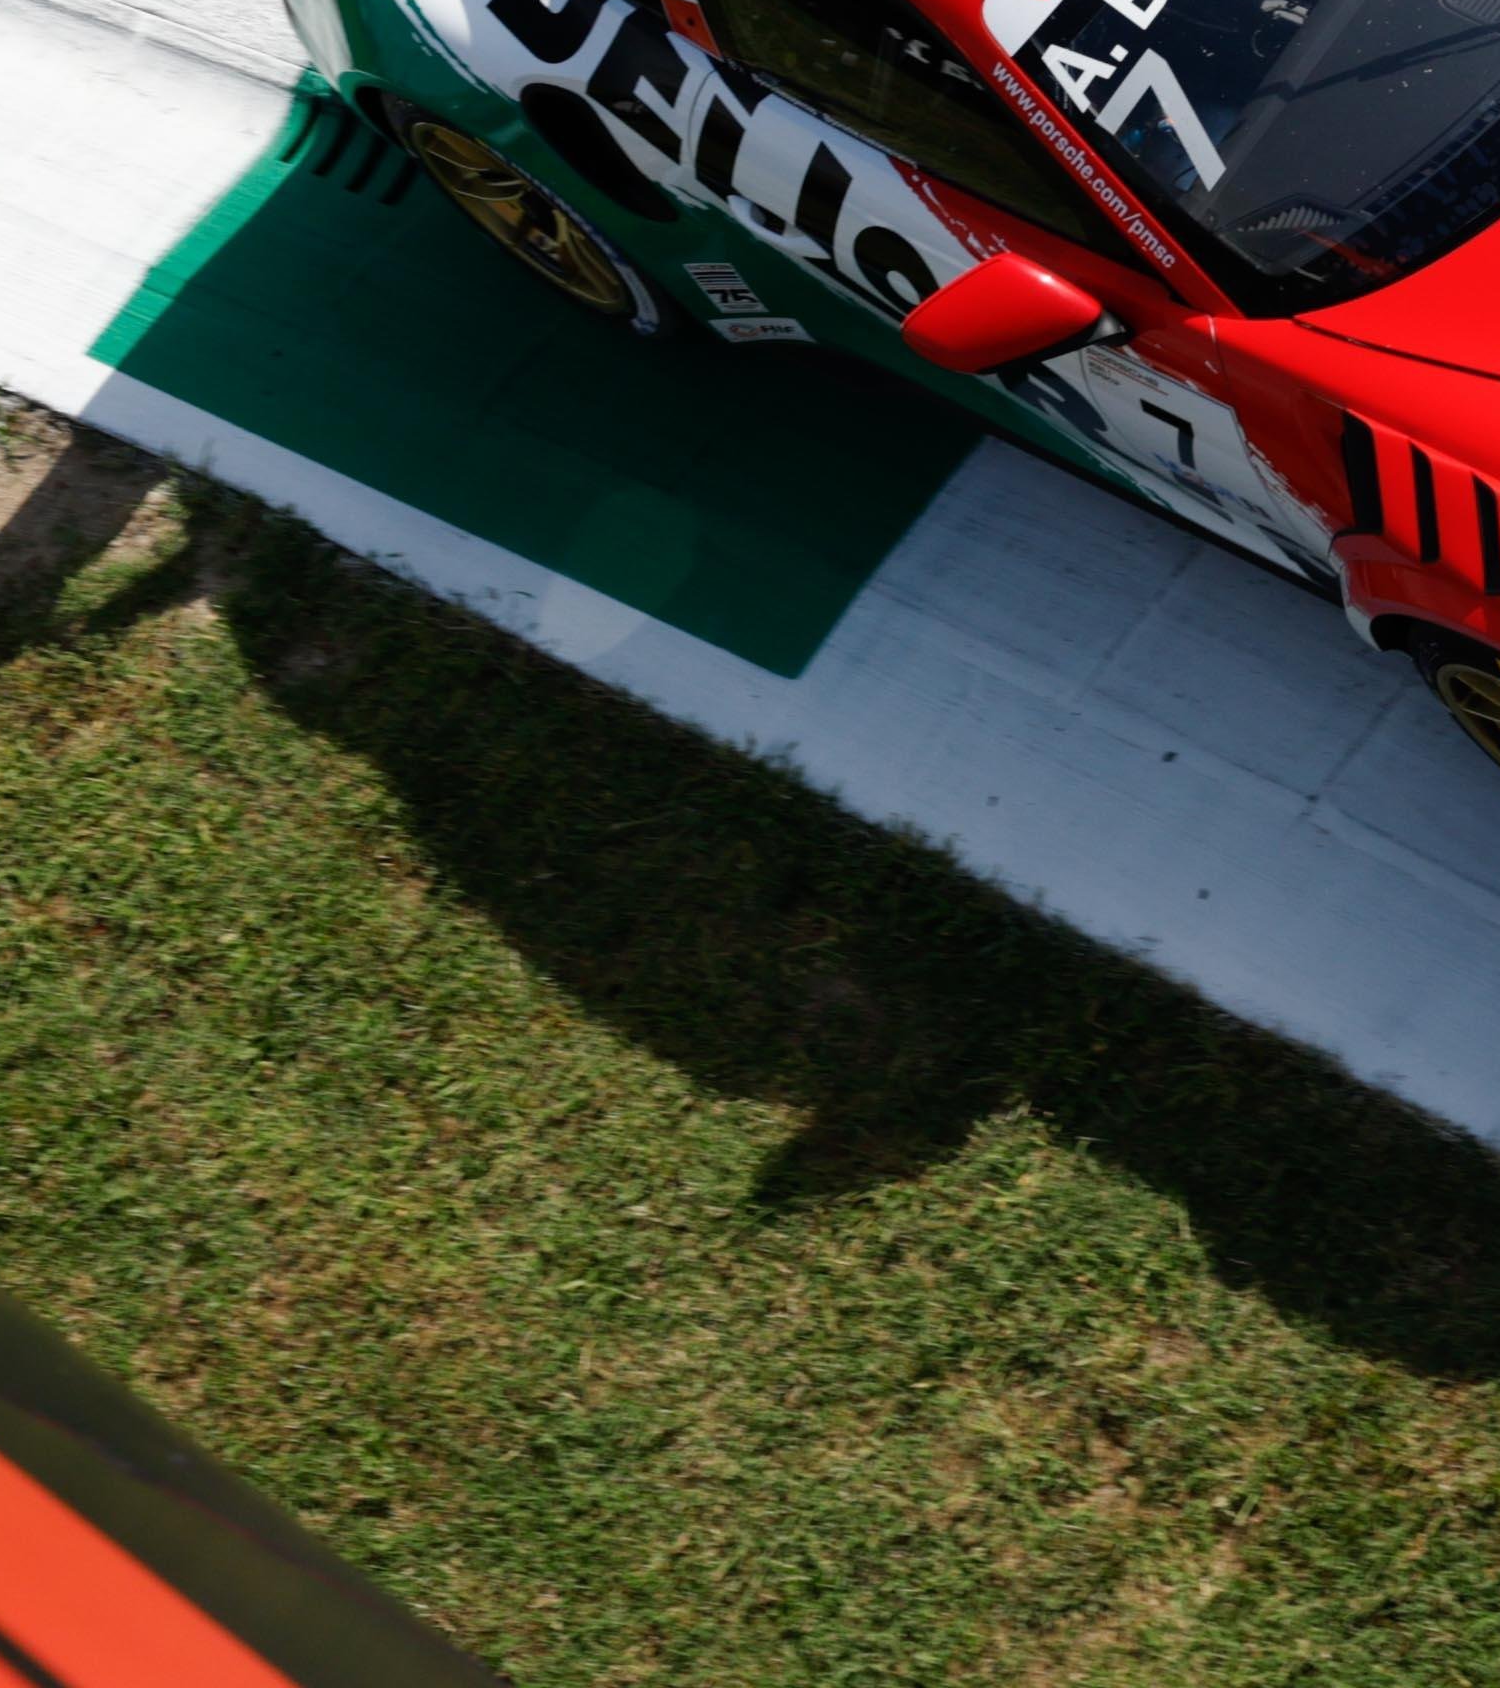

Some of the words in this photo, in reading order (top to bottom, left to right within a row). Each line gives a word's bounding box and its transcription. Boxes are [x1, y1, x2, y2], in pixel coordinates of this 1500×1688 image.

[1040, 42, 1130, 114] A.
[1095, 47, 1228, 193] 7
[991, 61, 1176, 269] www.porsche.com/pmsc
